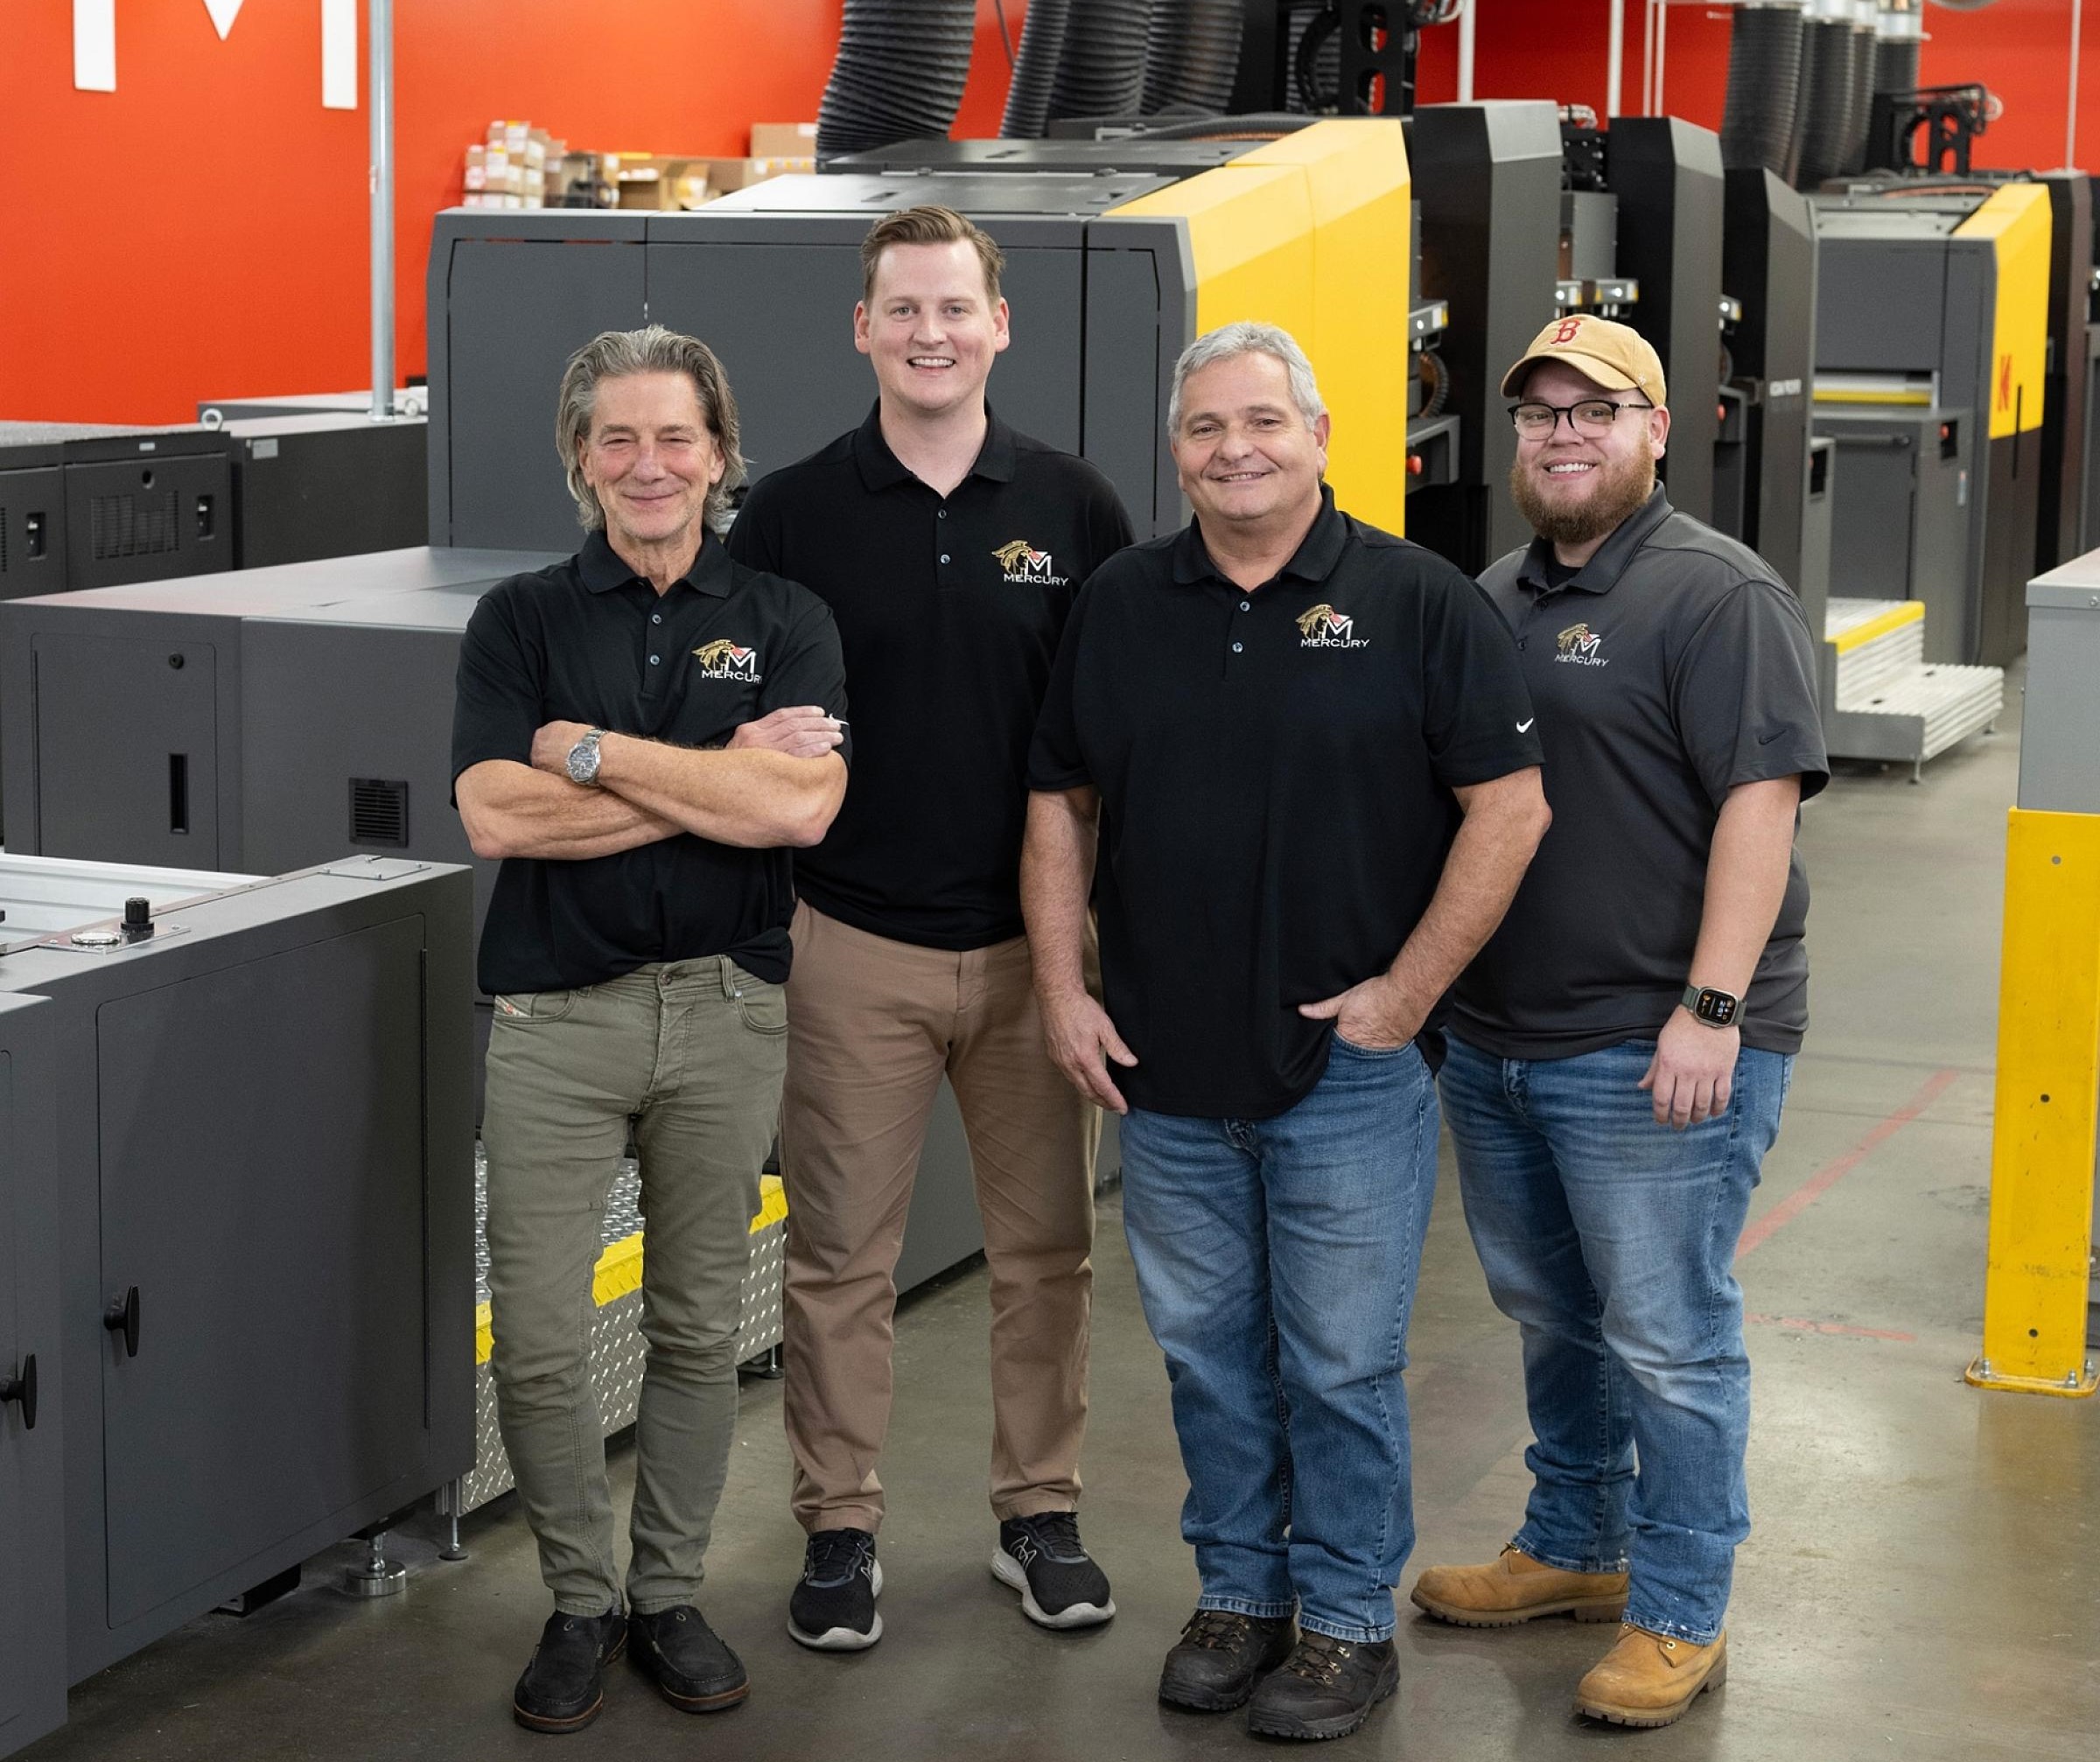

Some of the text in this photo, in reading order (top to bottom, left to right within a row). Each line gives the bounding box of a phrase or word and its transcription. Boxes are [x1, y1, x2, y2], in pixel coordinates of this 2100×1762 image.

[1550, 318, 1580, 344] B
[1004, 574, 1068, 586] MERCURY
[1300, 638, 1370, 648] MERCURY
[1554, 654, 1610, 667] MERCURY
[702, 669, 762, 683] MERCUR
